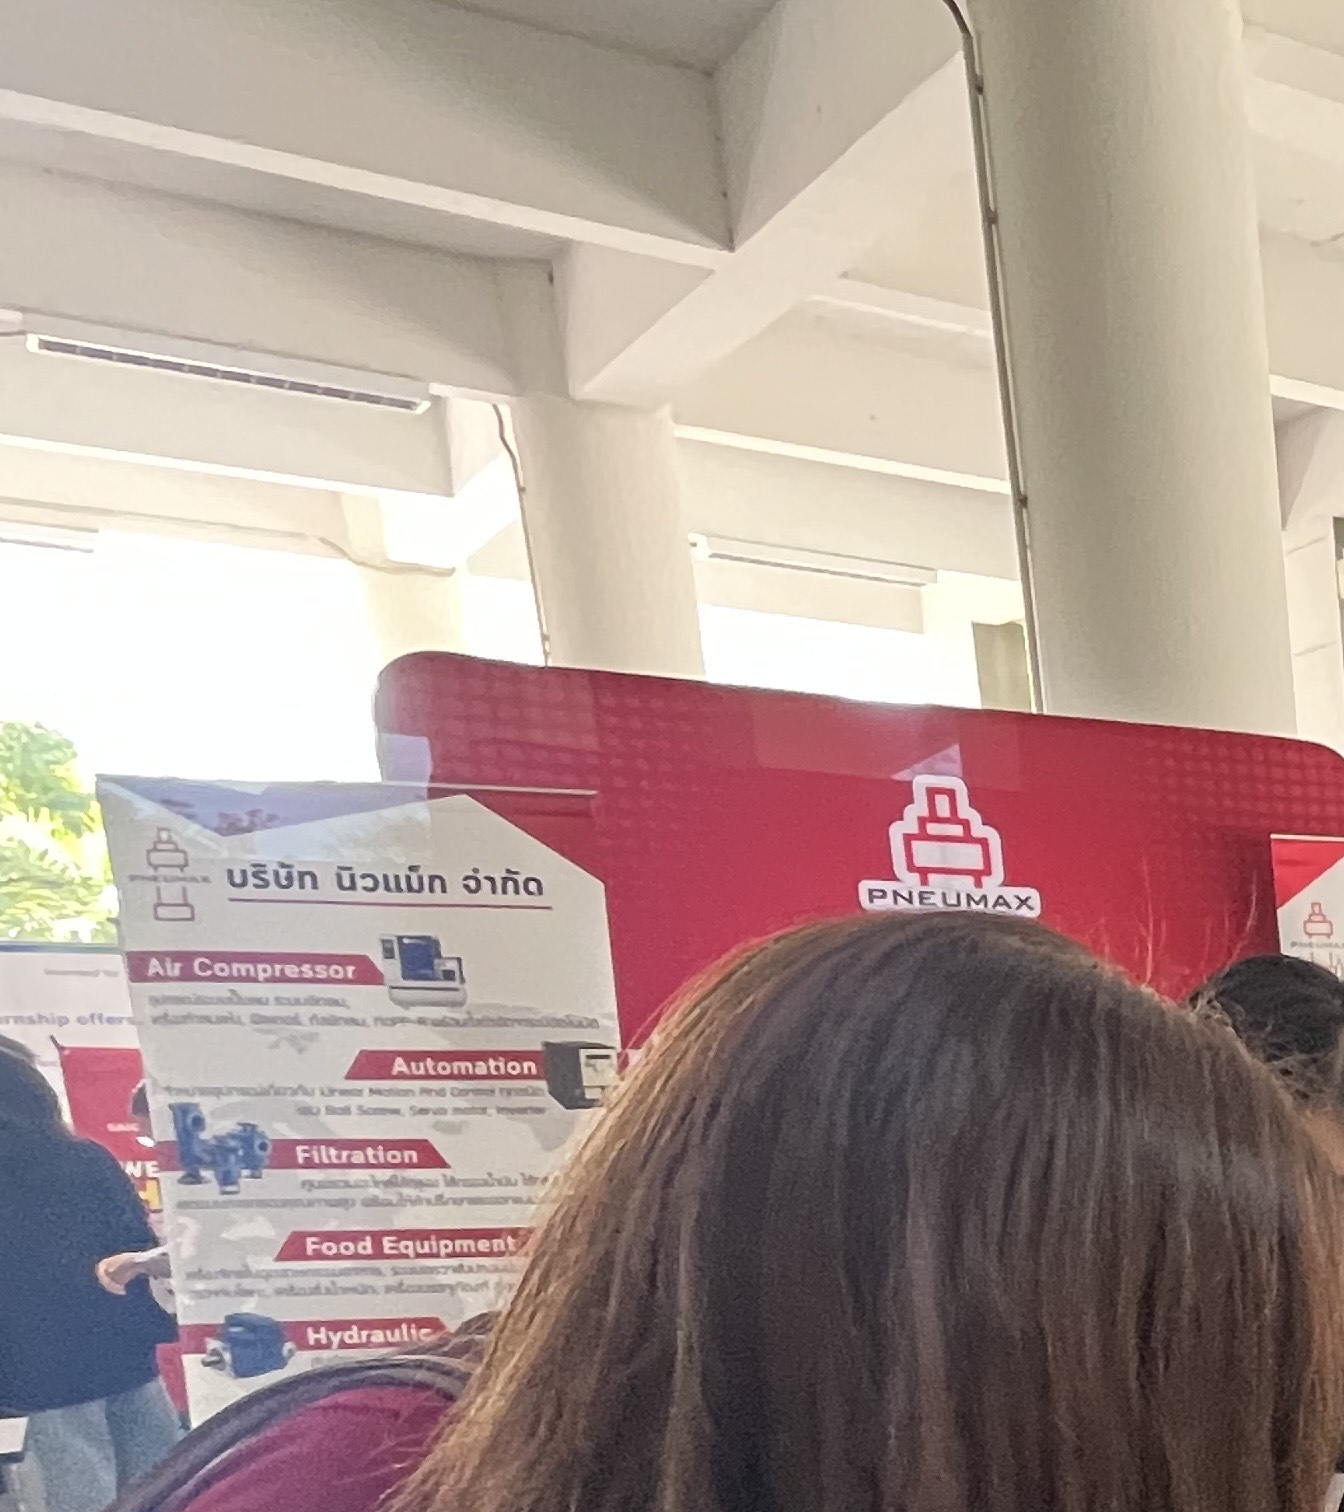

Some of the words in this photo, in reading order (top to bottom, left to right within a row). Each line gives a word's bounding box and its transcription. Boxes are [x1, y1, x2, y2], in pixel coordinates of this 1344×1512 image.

[227, 862, 318, 891] บริษัท
[336, 864, 447, 895] นิวแม็ก
[462, 867, 544, 896] จำกัด
[867, 888, 1035, 911] PNEUMAX
[147, 958, 182, 976] Air
[193, 958, 356, 982] Compressor
[391, 1056, 538, 1076] Automation
[296, 1146, 418, 1165] Filtration
[305, 1237, 372, 1256] Food
[383, 1236, 517, 1259] Equipment
[307, 1326, 433, 1349] Hydraulic
